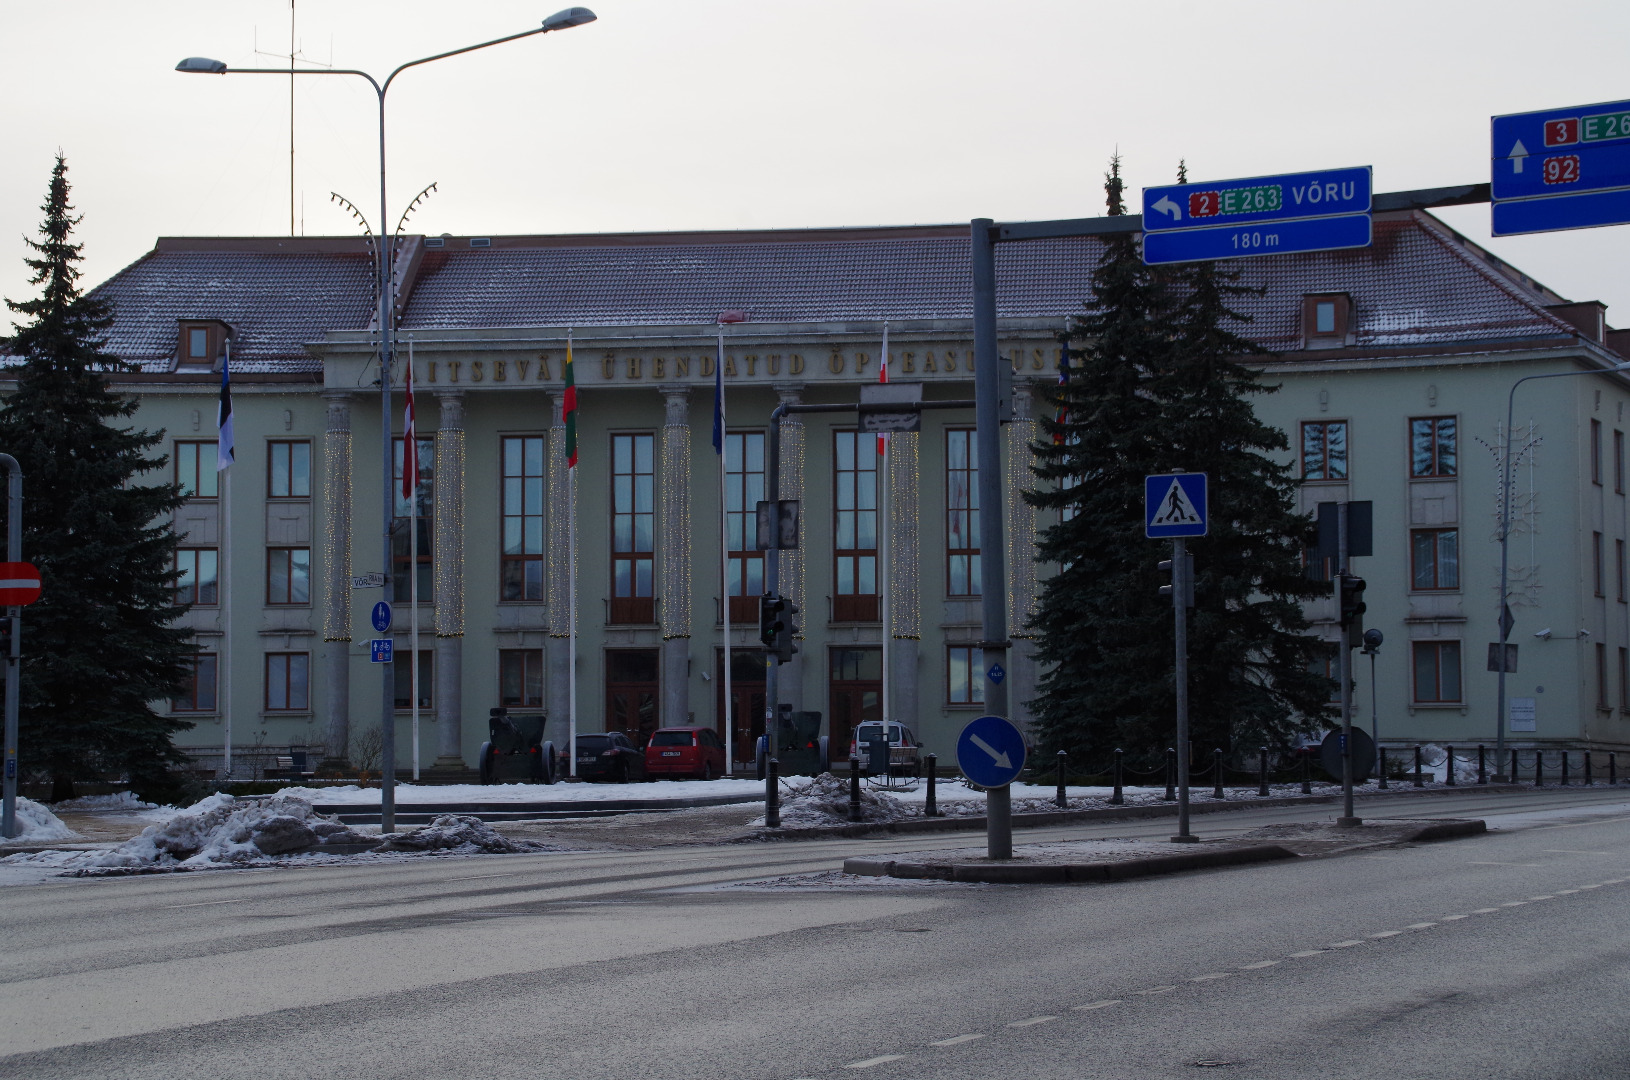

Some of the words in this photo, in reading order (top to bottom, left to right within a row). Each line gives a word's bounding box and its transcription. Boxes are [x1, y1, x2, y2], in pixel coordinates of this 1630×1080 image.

[1556, 123, 1568, 142] 3
[1585, 118, 1599, 139] E
[1548, 159, 1575, 181] 92
[1199, 195, 1209, 214] 2
[1224, 192, 1236, 211] E
[1242, 189, 1278, 210] 263
[1292, 181, 1355, 205] VÕRU
[1231, 232, 1261, 249] 180
[1265, 233, 1279, 246] m
[600, 352, 805, 379] ÜHENDATUD
